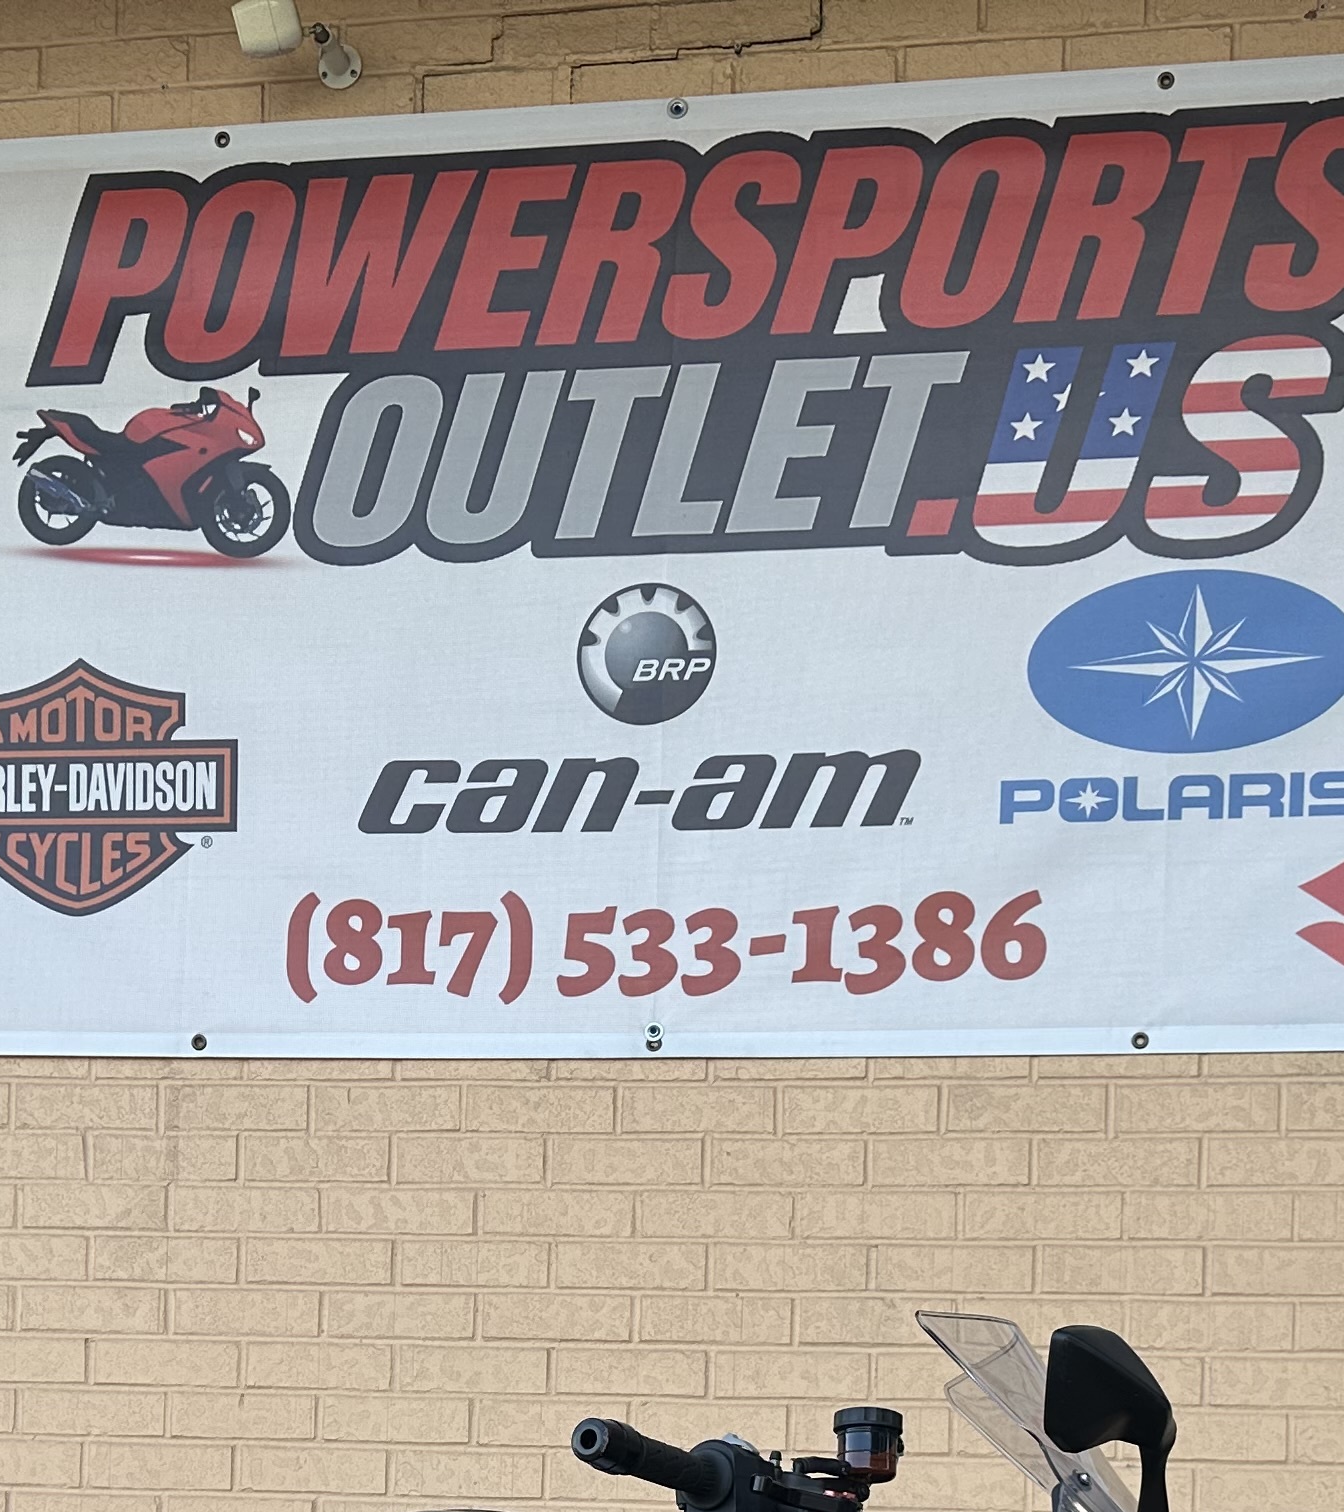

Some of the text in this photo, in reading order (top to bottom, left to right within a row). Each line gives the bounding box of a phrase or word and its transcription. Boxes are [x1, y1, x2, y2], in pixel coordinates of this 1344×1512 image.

[312, 333, 1333, 546] OUTLET.US
[632, 657, 711, 683] BRP
[8, 685, 153, 743] MOTOR
[6, 832, 151, 896] CYCLES
[285, 889, 1048, 1005] (817) 533-1386
